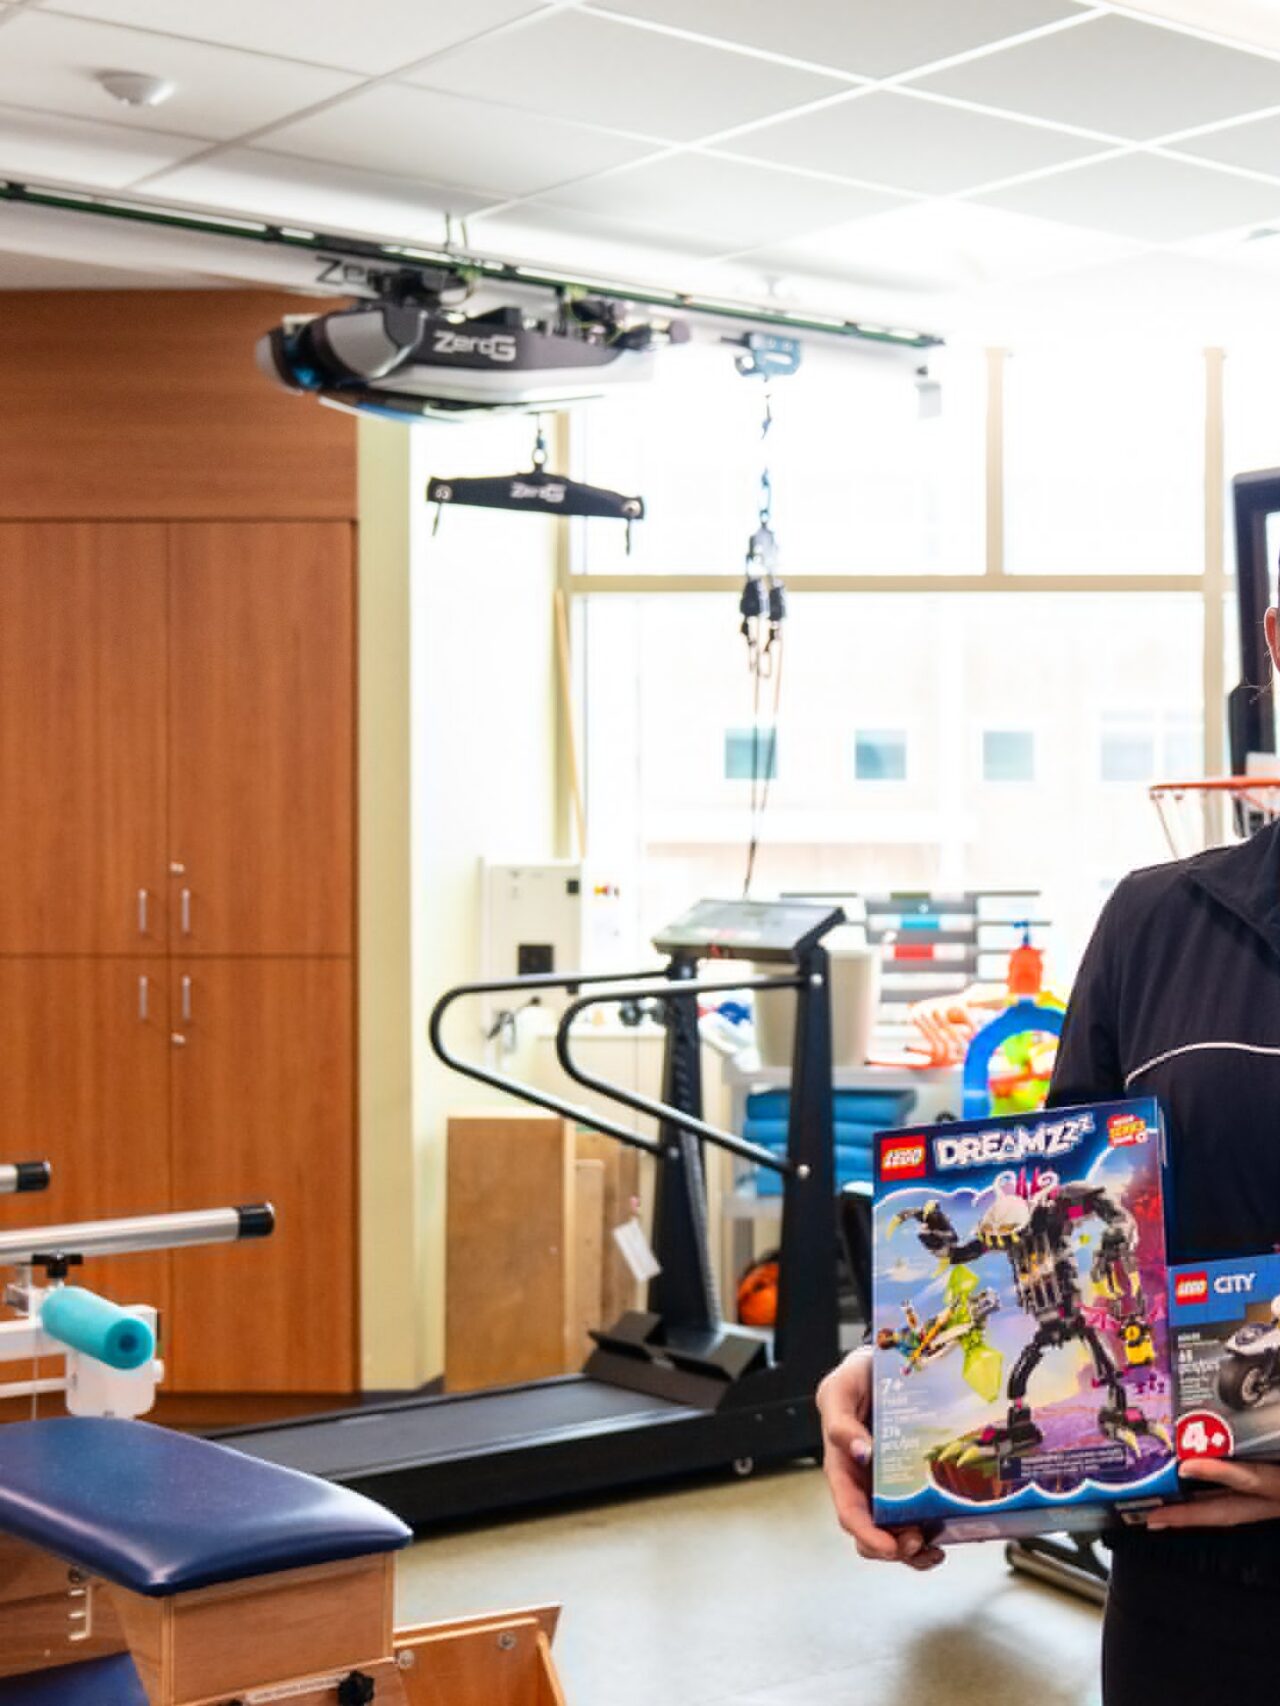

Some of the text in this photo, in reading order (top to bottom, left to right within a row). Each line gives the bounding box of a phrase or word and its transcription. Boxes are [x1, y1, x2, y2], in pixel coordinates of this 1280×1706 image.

[434, 330, 516, 362] ZeroG
[881, 1147, 925, 1170] LEGO
[1214, 1272, 1257, 1294] CITY
[1181, 1420, 1227, 1454] 4+
